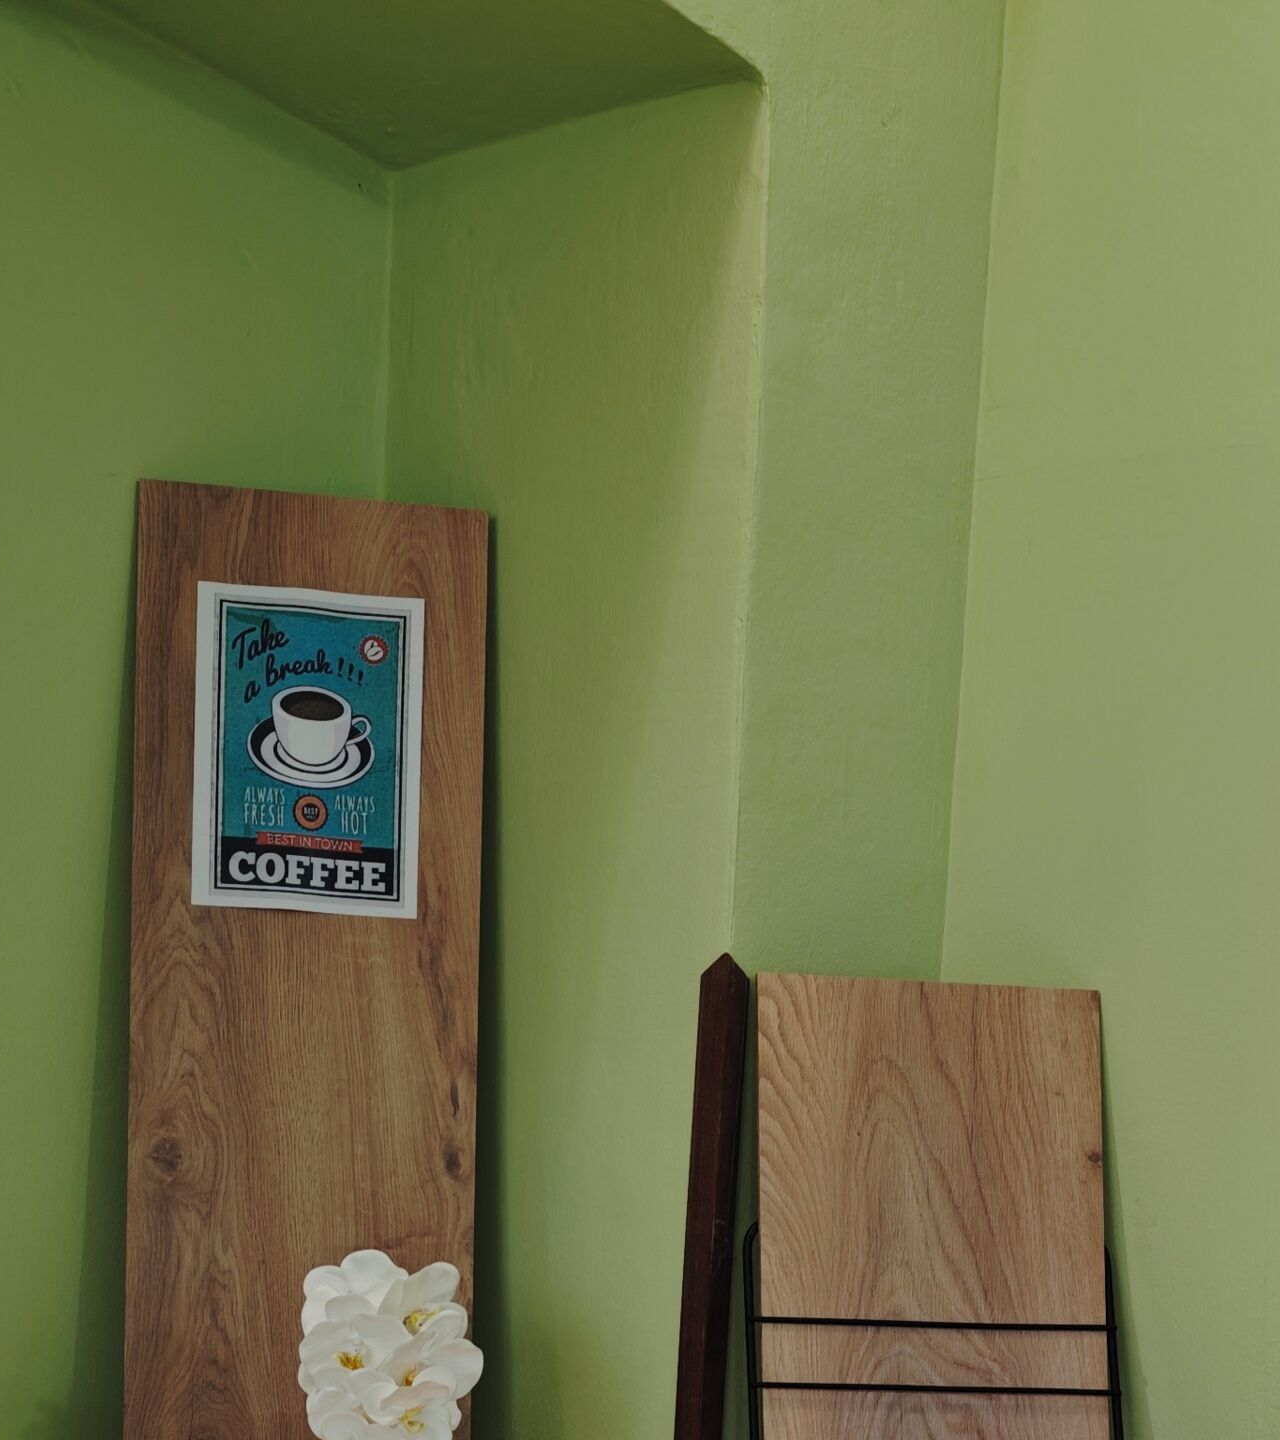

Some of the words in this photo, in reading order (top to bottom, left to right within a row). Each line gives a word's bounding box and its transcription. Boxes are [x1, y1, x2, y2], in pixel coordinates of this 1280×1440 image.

[231, 618, 291, 670] Take
[243, 680, 261, 704] a
[244, 786, 287, 805] ALWAYS
[334, 794, 376, 814] ALWAYS
[244, 804, 285, 827] FRESH
[340, 811, 368, 836] HOT
[267, 833, 297, 845] BEST
[298, 835, 312, 847] IN
[316, 838, 353, 851] TOWN
[228, 851, 387, 894] COFFEE
